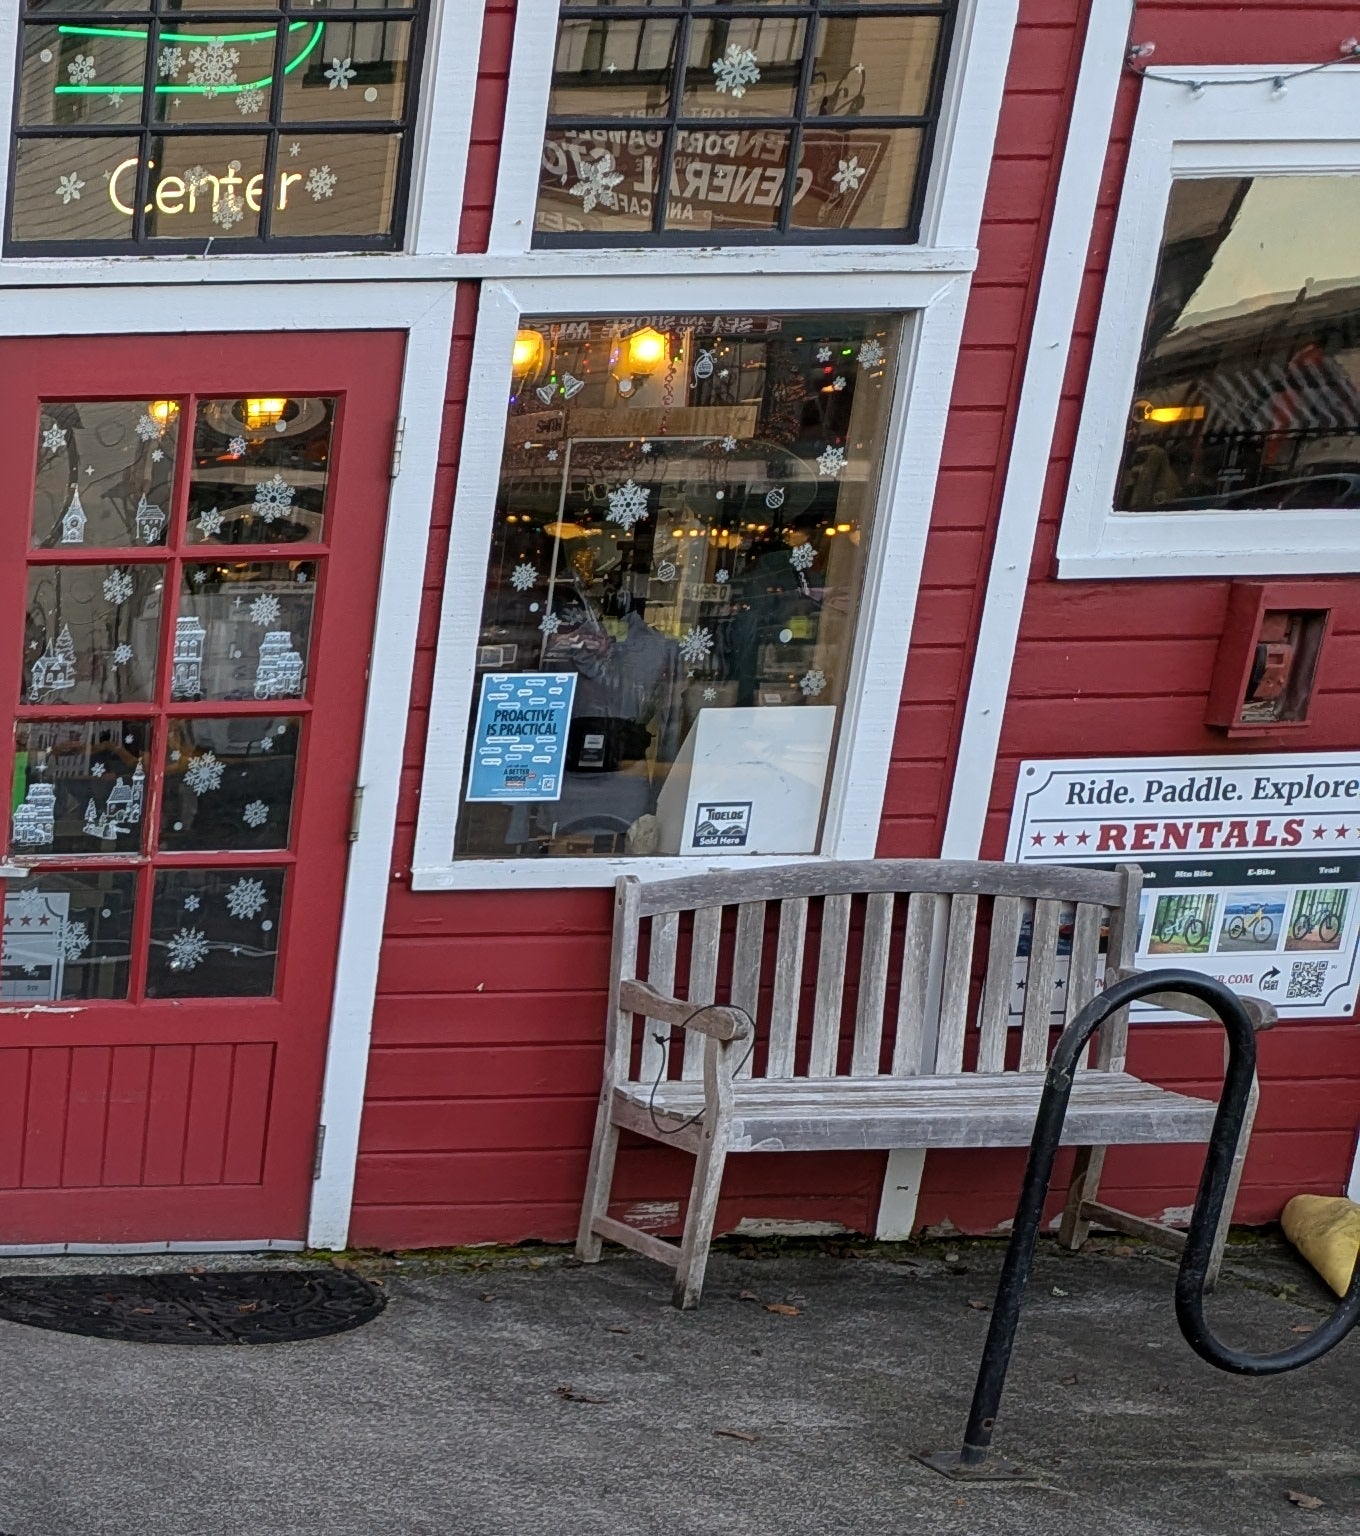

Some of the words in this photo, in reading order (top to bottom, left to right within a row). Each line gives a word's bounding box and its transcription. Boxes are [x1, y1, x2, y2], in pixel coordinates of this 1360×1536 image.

[109, 158, 303, 215] Center
[493, 709, 555, 722] PROACTIVE
[486, 724, 496, 736] IS
[499, 723, 558, 735] PRACTICAL
[1065, 779, 1135, 805] Ride.
[1143, 777, 1243, 804] Paddle.
[699, 837, 718, 846] Sold
[720, 837, 740, 845] Here
[1096, 819, 1305, 851] RENTALS
[1193, 870, 1213, 878] Bike
[1247, 868, 1276, 877] E-Bike
[1319, 866, 1340, 874] Trail
